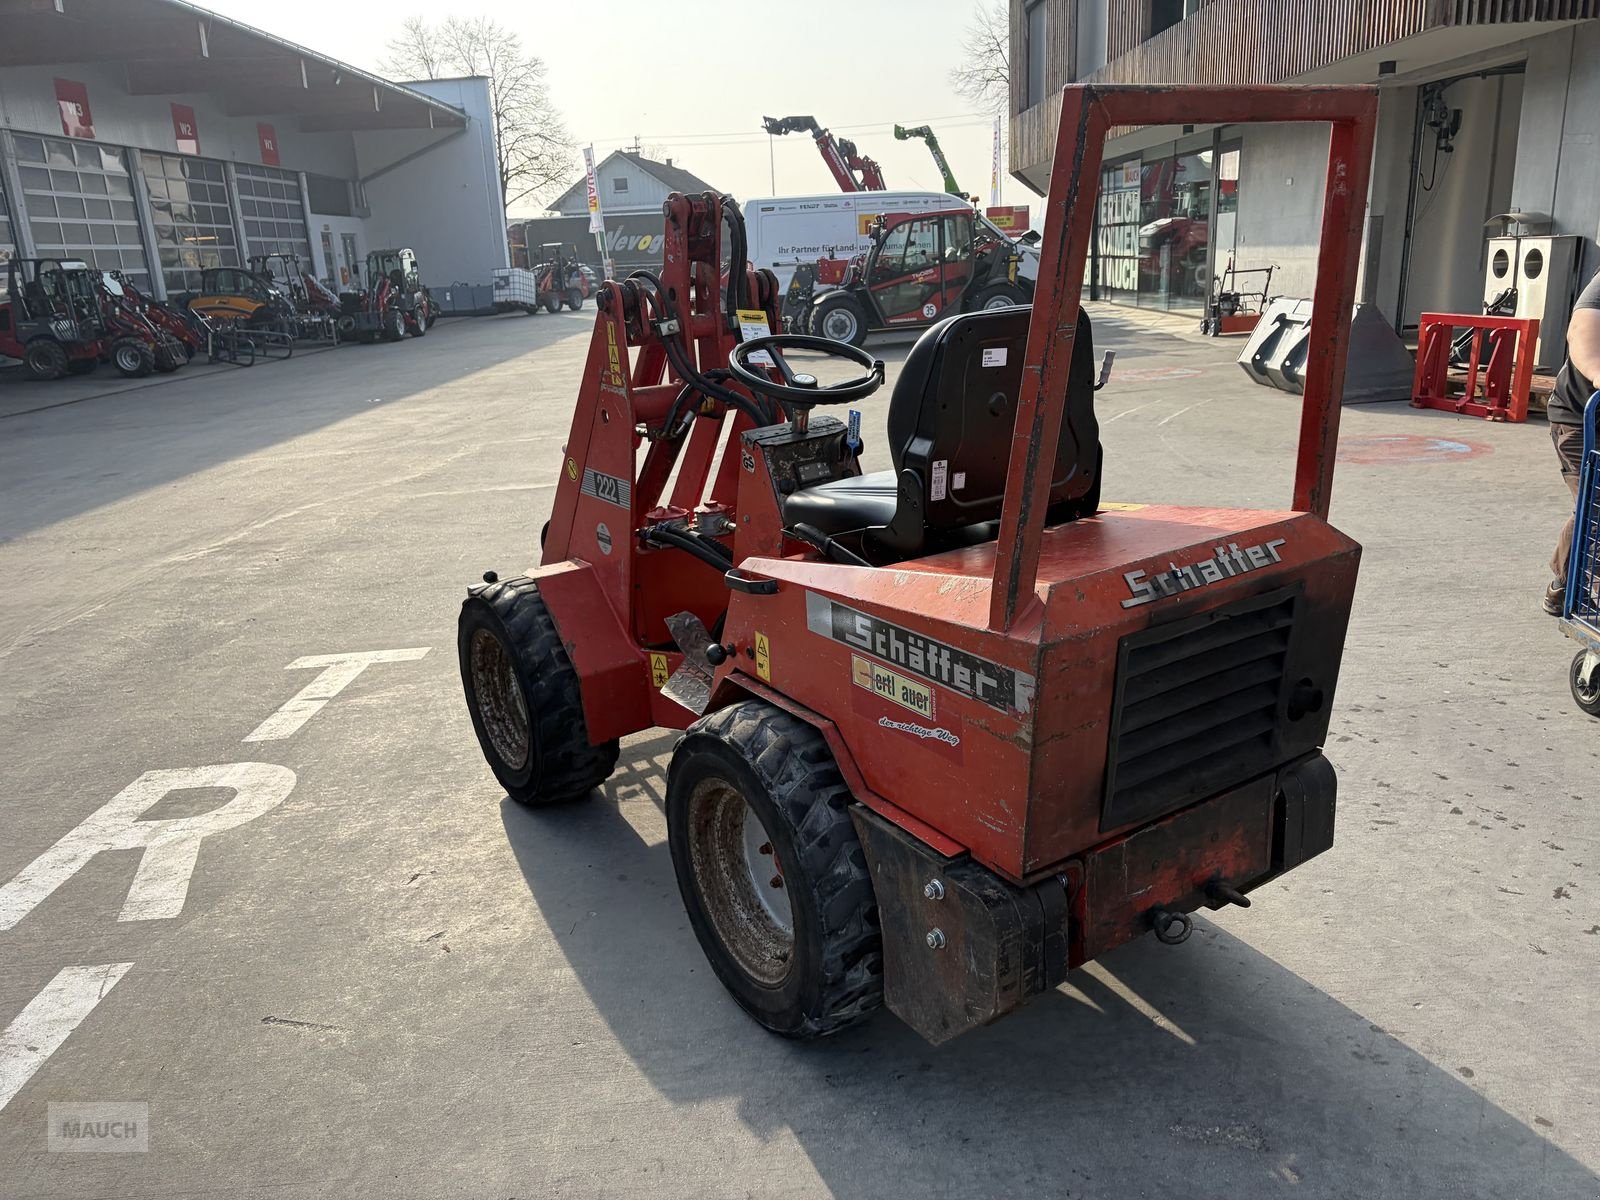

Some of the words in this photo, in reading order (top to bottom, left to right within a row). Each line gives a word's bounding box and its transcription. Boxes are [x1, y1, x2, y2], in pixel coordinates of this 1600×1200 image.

[67, 102, 83, 117] W3
[179, 122, 193, 136] W2
[263, 139, 274, 150] W1
[931, 150, 948, 178] MERLO
[605, 225, 665, 254] Nevog
[778, 246, 790, 254] Ihr
[791, 245, 820, 254] Partner
[836, 243, 858, 252] Land-
[925, 305, 935, 316] 35
[846, 614, 998, 697] Schäffer
[875, 672, 896, 697] ertl
[901, 686, 929, 712] auer
[879, 717, 895, 728] der
[896, 722, 933, 738] richtige
[935, 728, 960, 746] Weg
